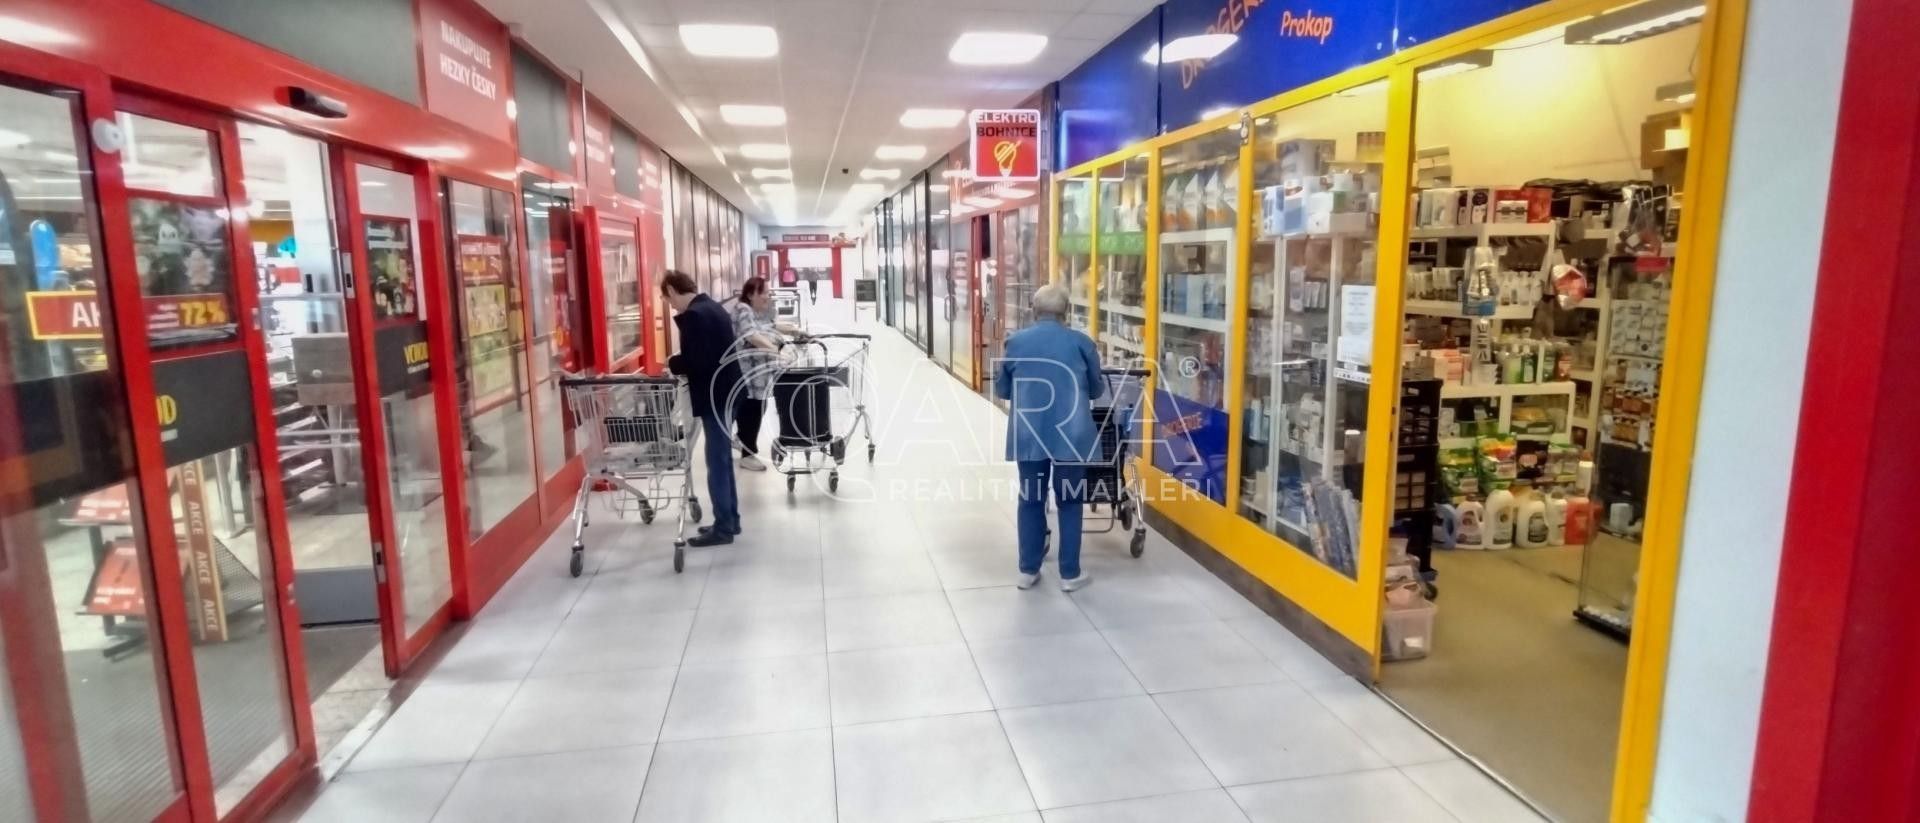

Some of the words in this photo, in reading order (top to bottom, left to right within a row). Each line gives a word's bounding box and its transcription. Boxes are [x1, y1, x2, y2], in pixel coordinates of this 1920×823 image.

[1280, 9, 1333, 45] Prokop
[440, 53, 470, 87] HEZKY
[472, 65, 496, 101] ČESKY
[977, 111, 1037, 124] ELEKTRO
[977, 126, 1037, 137] BOHNICE
[188, 501, 204, 536] AKCE
[197, 551, 212, 585] AKCE
[203, 599, 218, 632] AKCE
